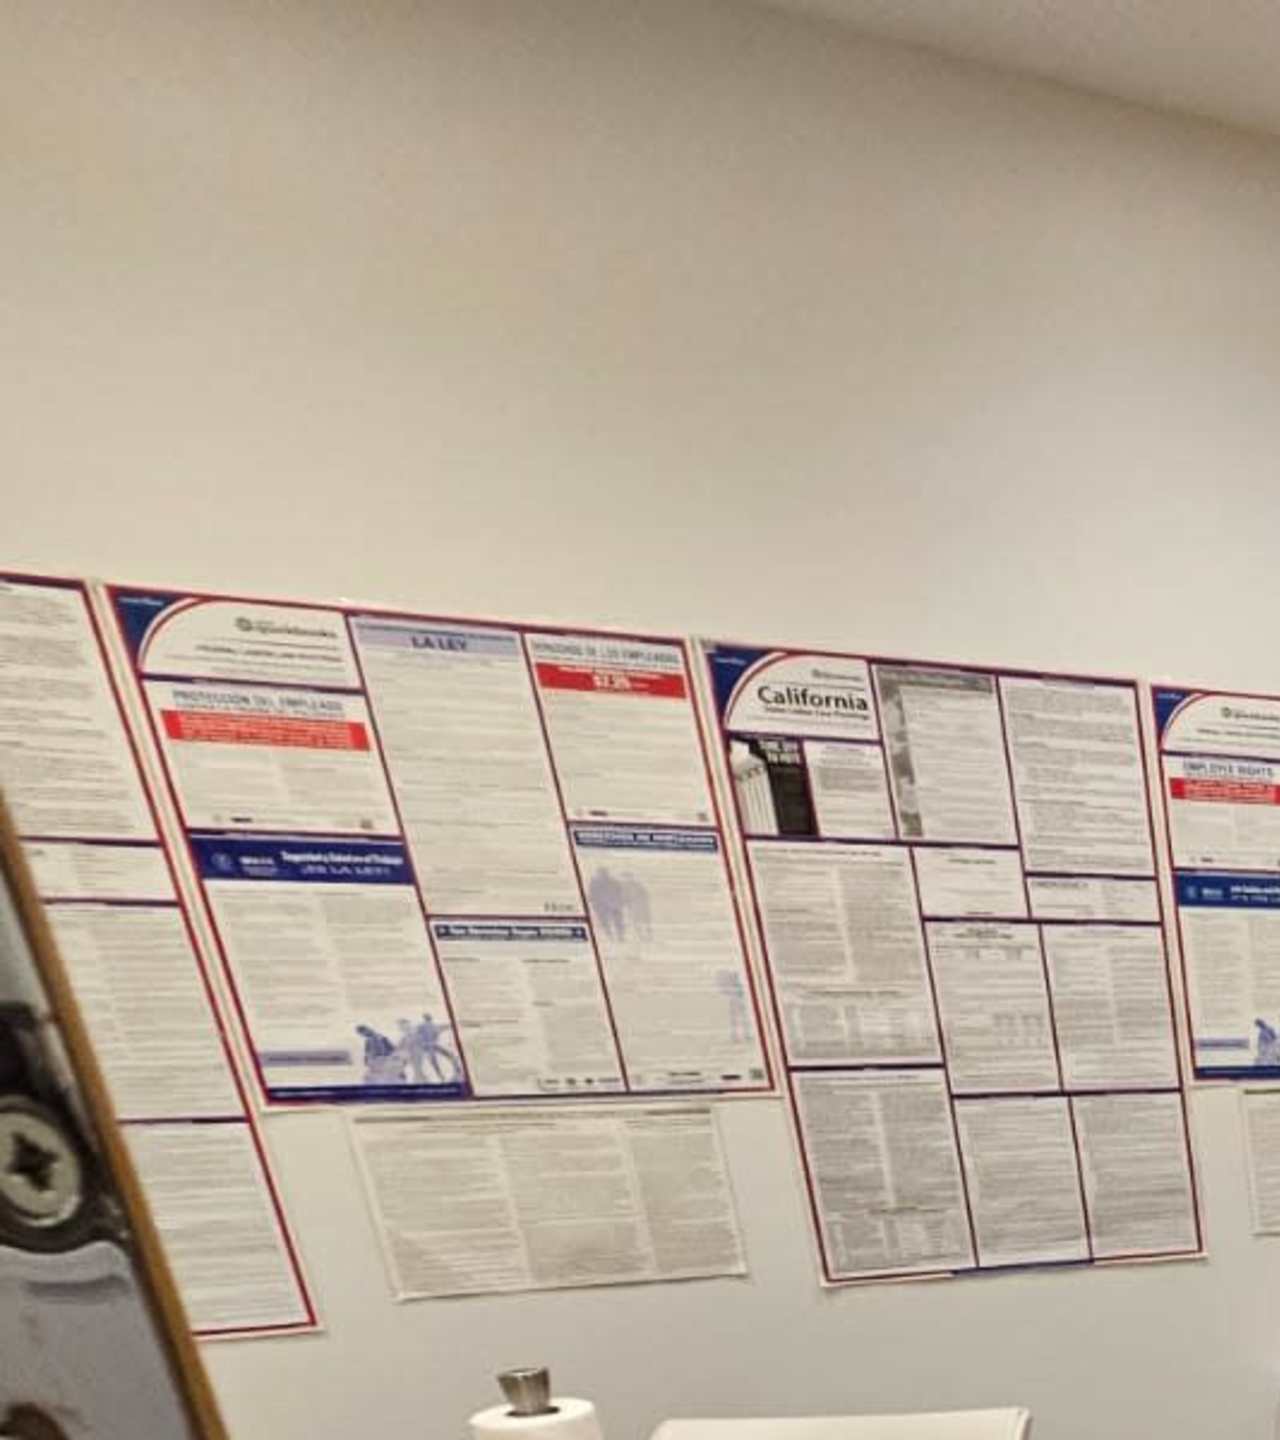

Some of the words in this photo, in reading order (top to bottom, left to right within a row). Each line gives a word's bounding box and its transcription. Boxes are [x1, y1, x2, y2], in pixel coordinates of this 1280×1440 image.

[412, 635, 433, 649] LA
[437, 637, 467, 651] LEY
[758, 685, 869, 711] California
